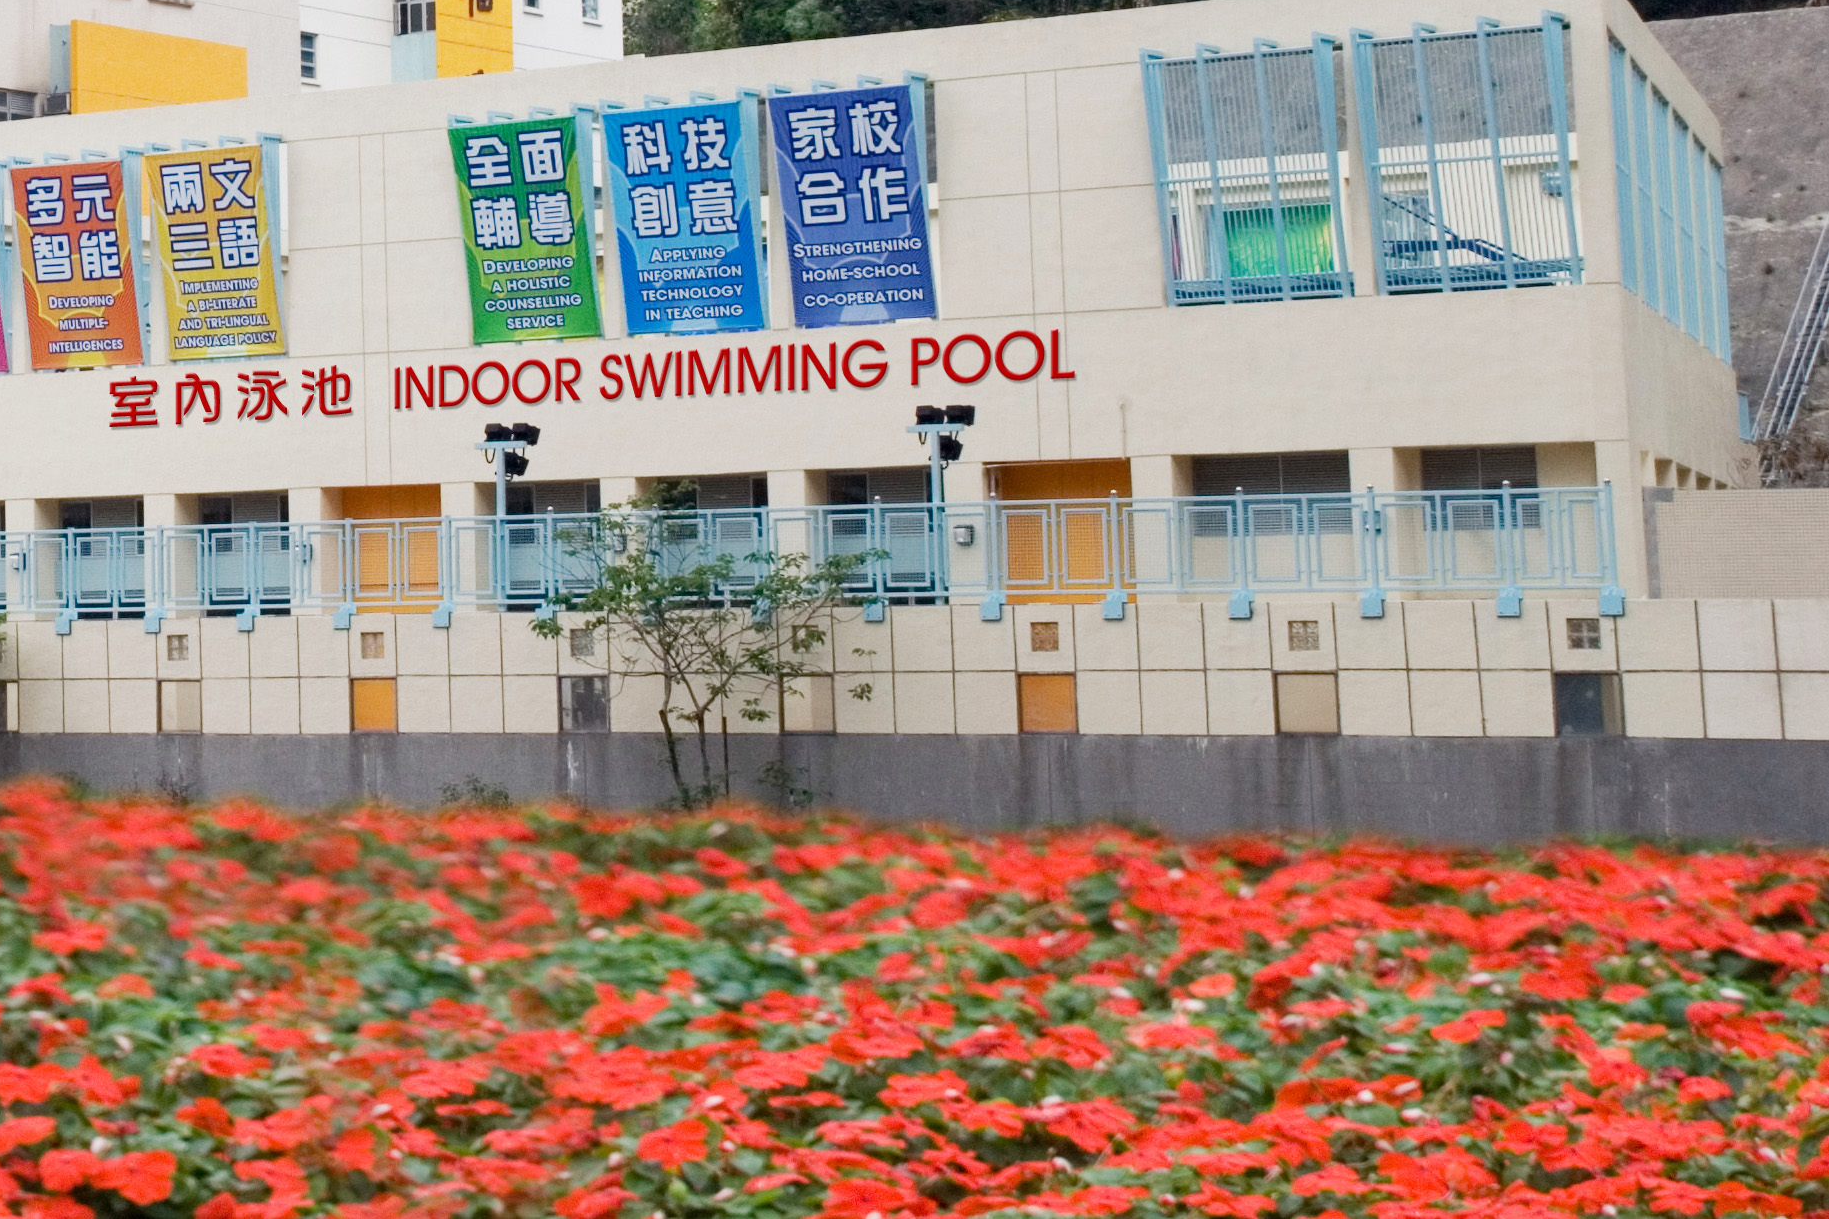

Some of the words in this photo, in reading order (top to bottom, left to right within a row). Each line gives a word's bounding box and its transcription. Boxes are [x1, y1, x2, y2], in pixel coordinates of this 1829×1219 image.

[787, 99, 902, 162] 家校
[621, 116, 731, 176] 科技
[465, 128, 566, 187] 全面
[160, 158, 256, 215] 兩文
[797, 165, 910, 226] 合作
[25, 173, 115, 226] 多元
[629, 178, 739, 238] 創意
[471, 191, 575, 250] 輔導
[169, 216, 259, 271] 三語
[793, 237, 922, 258] STRENGTHENING
[31, 229, 122, 283] 智能
[650, 246, 725, 263] APPLYING
[483, 256, 574, 274] DEVELOPING
[639, 265, 742, 283] INFORMATION
[802, 264, 921, 282] HOME-SCHOOL
[180, 278, 258, 295] IMPLEMENTING
[492, 280, 503, 293] A
[506, 275, 571, 290] HOLISTIC
[641, 285, 743, 301] TECHNOLOGY
[48, 295, 114, 310] DEVELOPING
[187, 300, 197, 312] A
[198, 296, 257, 311] BI-LITERATE
[485, 294, 582, 312] COUNSELLING
[804, 288, 923, 306] CO-OPERATION
[645, 308, 661, 321] IN
[666, 304, 743, 320] TEACHING
[178, 318, 202, 331] AND
[205, 314, 269, 329] TRI-LINGUAL
[506, 314, 564, 330] SERVICE
[48, 338, 123, 353] INTELLIGENCES
[174, 334, 235, 349] LANGUAGE
[238, 331, 277, 346] POLICY
[394, 357, 581, 411] INDOOR
[599, 339, 888, 401] SWIMMING
[910, 328, 1075, 387] POOL
[109, 364, 352, 428] 室內泳池
